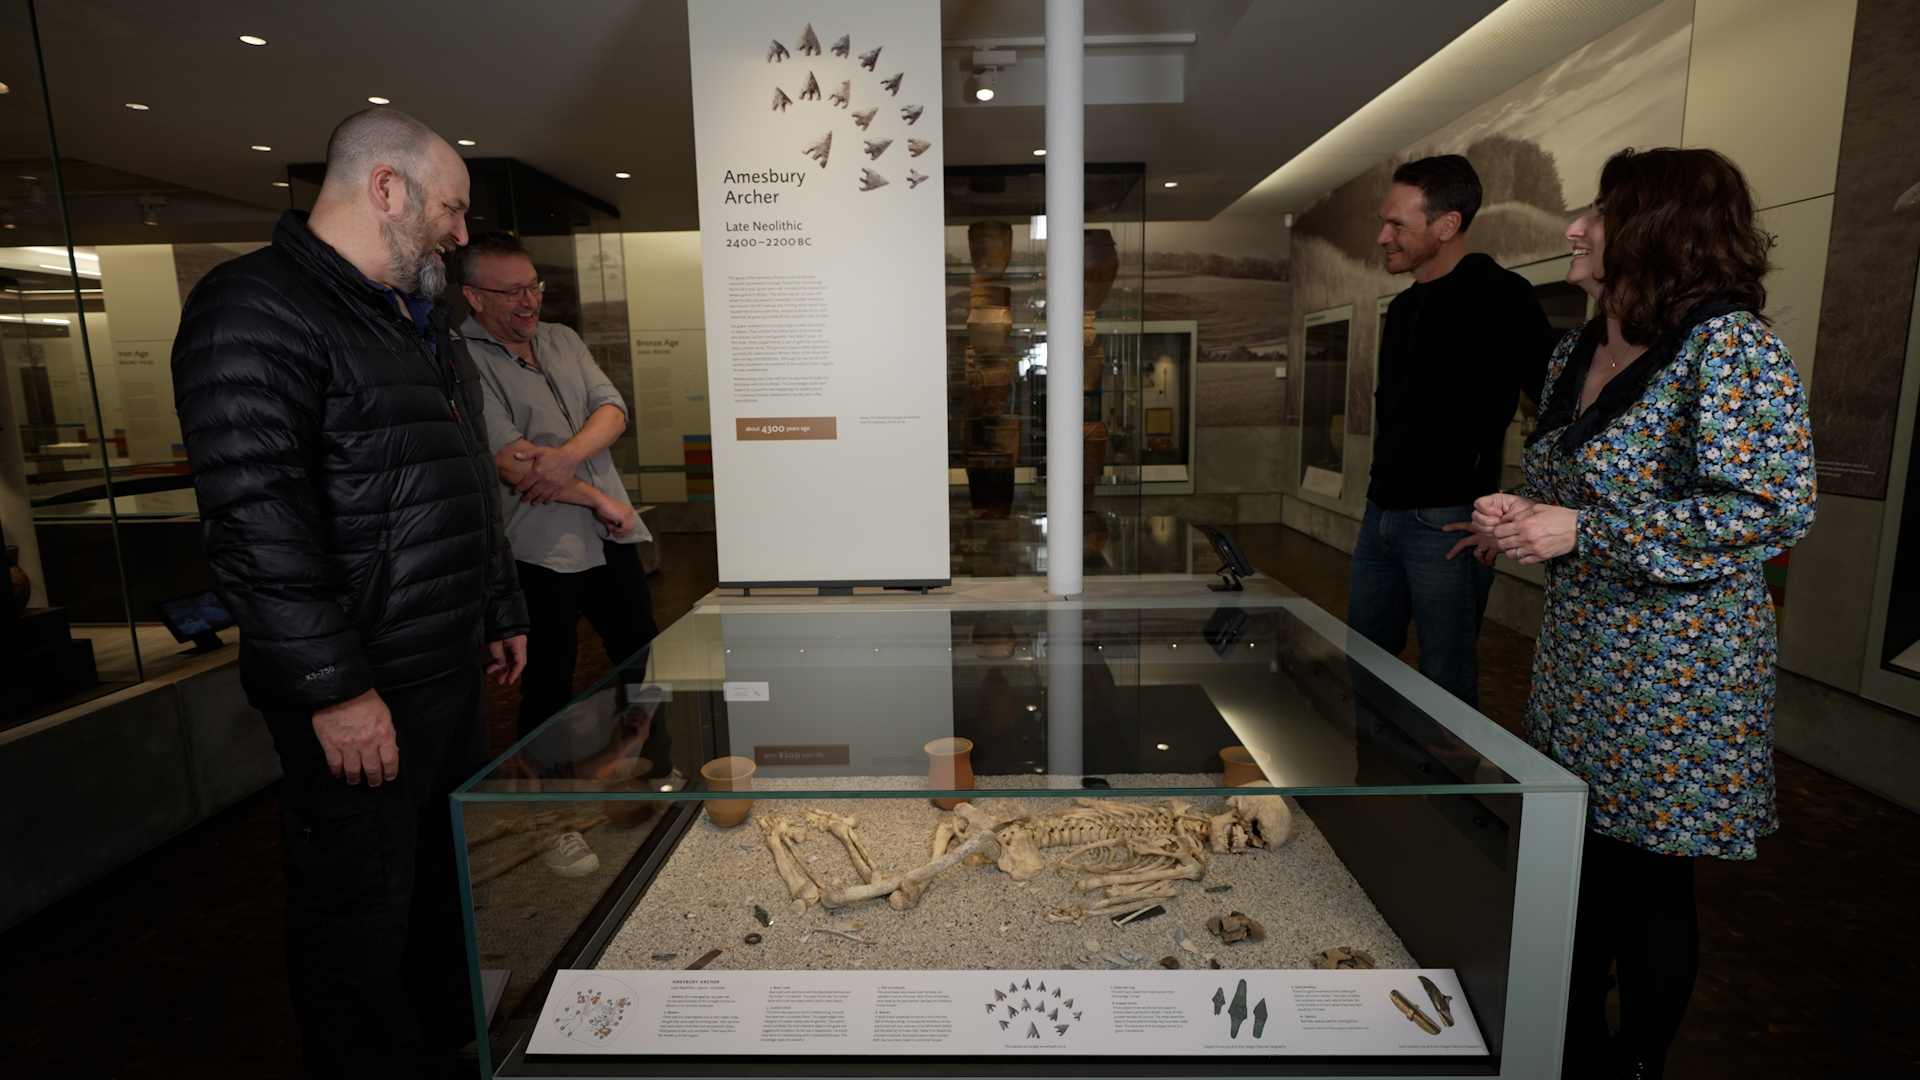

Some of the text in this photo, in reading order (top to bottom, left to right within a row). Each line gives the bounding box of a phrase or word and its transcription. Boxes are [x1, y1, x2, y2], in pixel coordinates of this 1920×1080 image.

[724, 169, 806, 187] Amesbury
[725, 189, 779, 204] Archer
[726, 220, 803, 232] Late Neolithic
[664, 339, 679, 348] Age
[134, 350, 148, 358] Age
[761, 425, 785, 434] 4300
